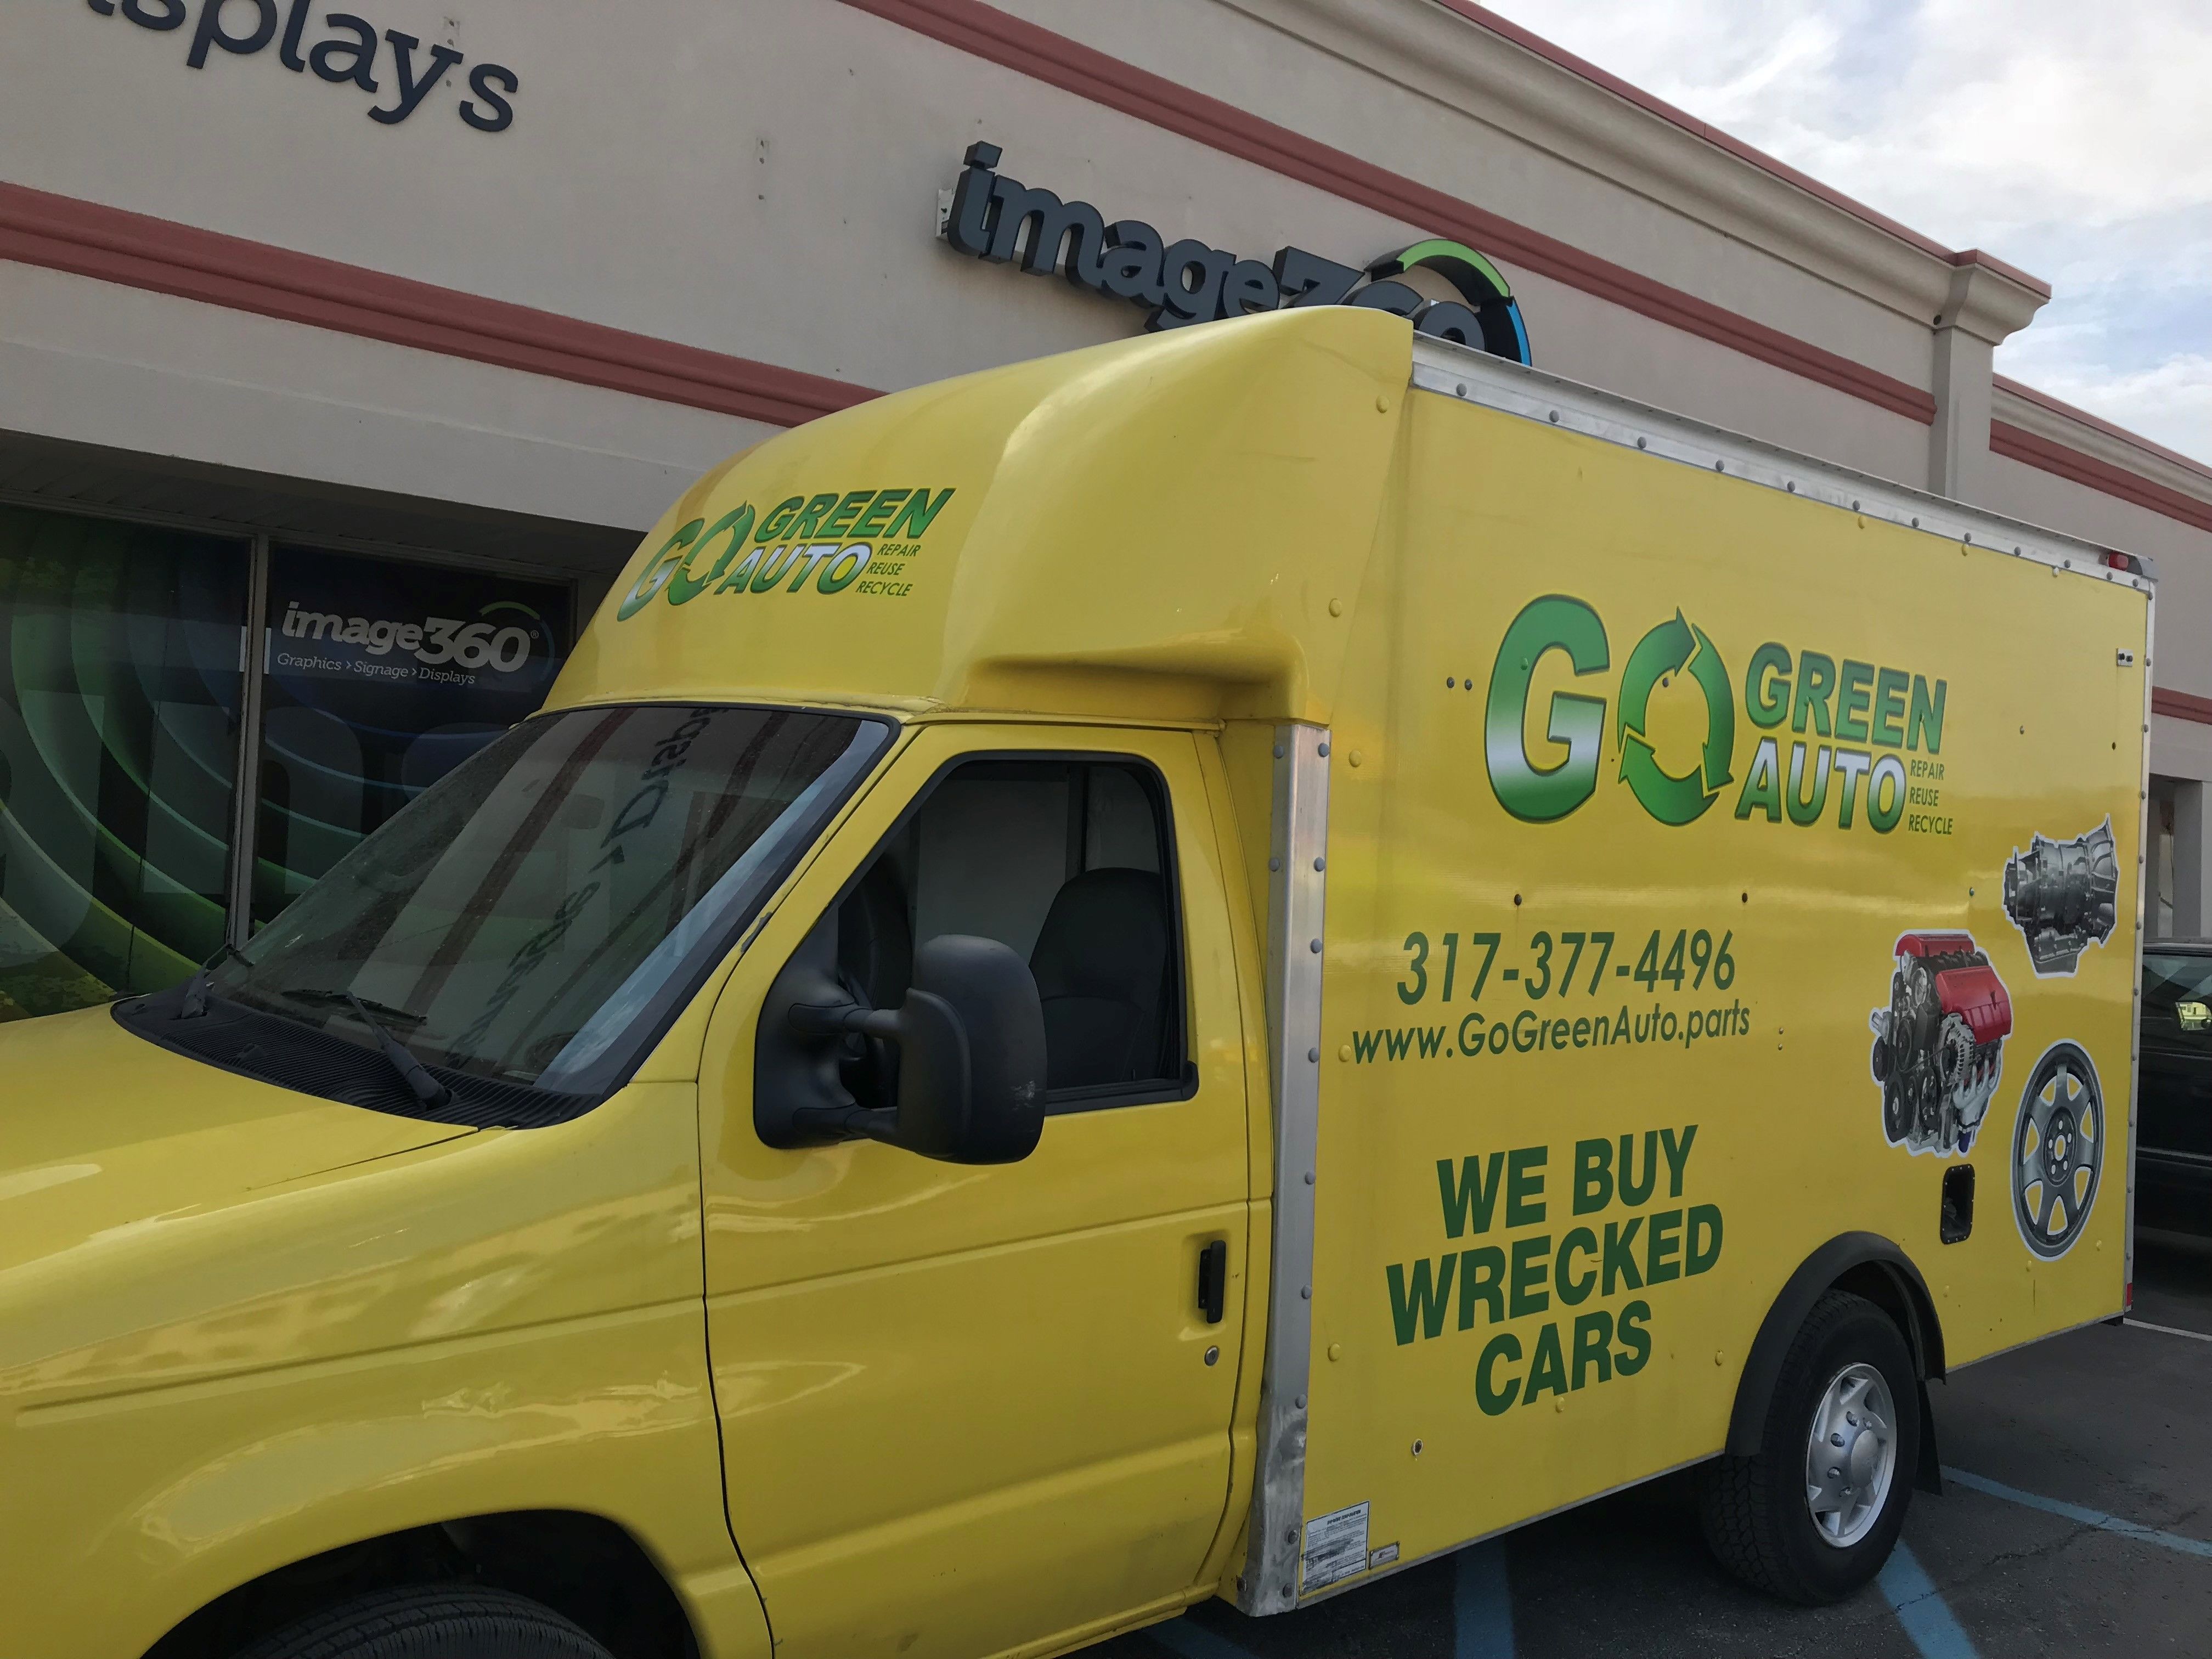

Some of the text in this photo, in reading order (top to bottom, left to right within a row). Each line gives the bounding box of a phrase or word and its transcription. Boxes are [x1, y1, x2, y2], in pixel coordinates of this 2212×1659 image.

[947, 140, 1486, 351] image
[753, 487, 956, 543] GREEN
[617, 500, 755, 622] GO
[714, 541, 872, 595] AUTO
[866, 561, 905, 576] REUSE
[877, 543, 921, 557] REPAIR
[855, 580, 913, 597] RECYCLE
[278, 654, 476, 685] Graphics Signage Displays
[1745, 641, 1948, 755] GREEN
[1485, 594, 1735, 826] GO
[1735, 736, 1907, 834] AUTO
[1909, 787, 1939, 806] REUSE
[1910, 759, 1945, 780] REPAIR
[1908, 814, 1953, 835] RECYCLE
[1397, 929, 1735, 1005] 317-377-4496
[1352, 998, 1751, 1064] www.GoGreenAuto.parts
[1436, 1124, 1699, 1239] WE BUY
[1386, 1204, 1724, 1346] WRECKED
[1475, 1300, 1652, 1416] CARS
